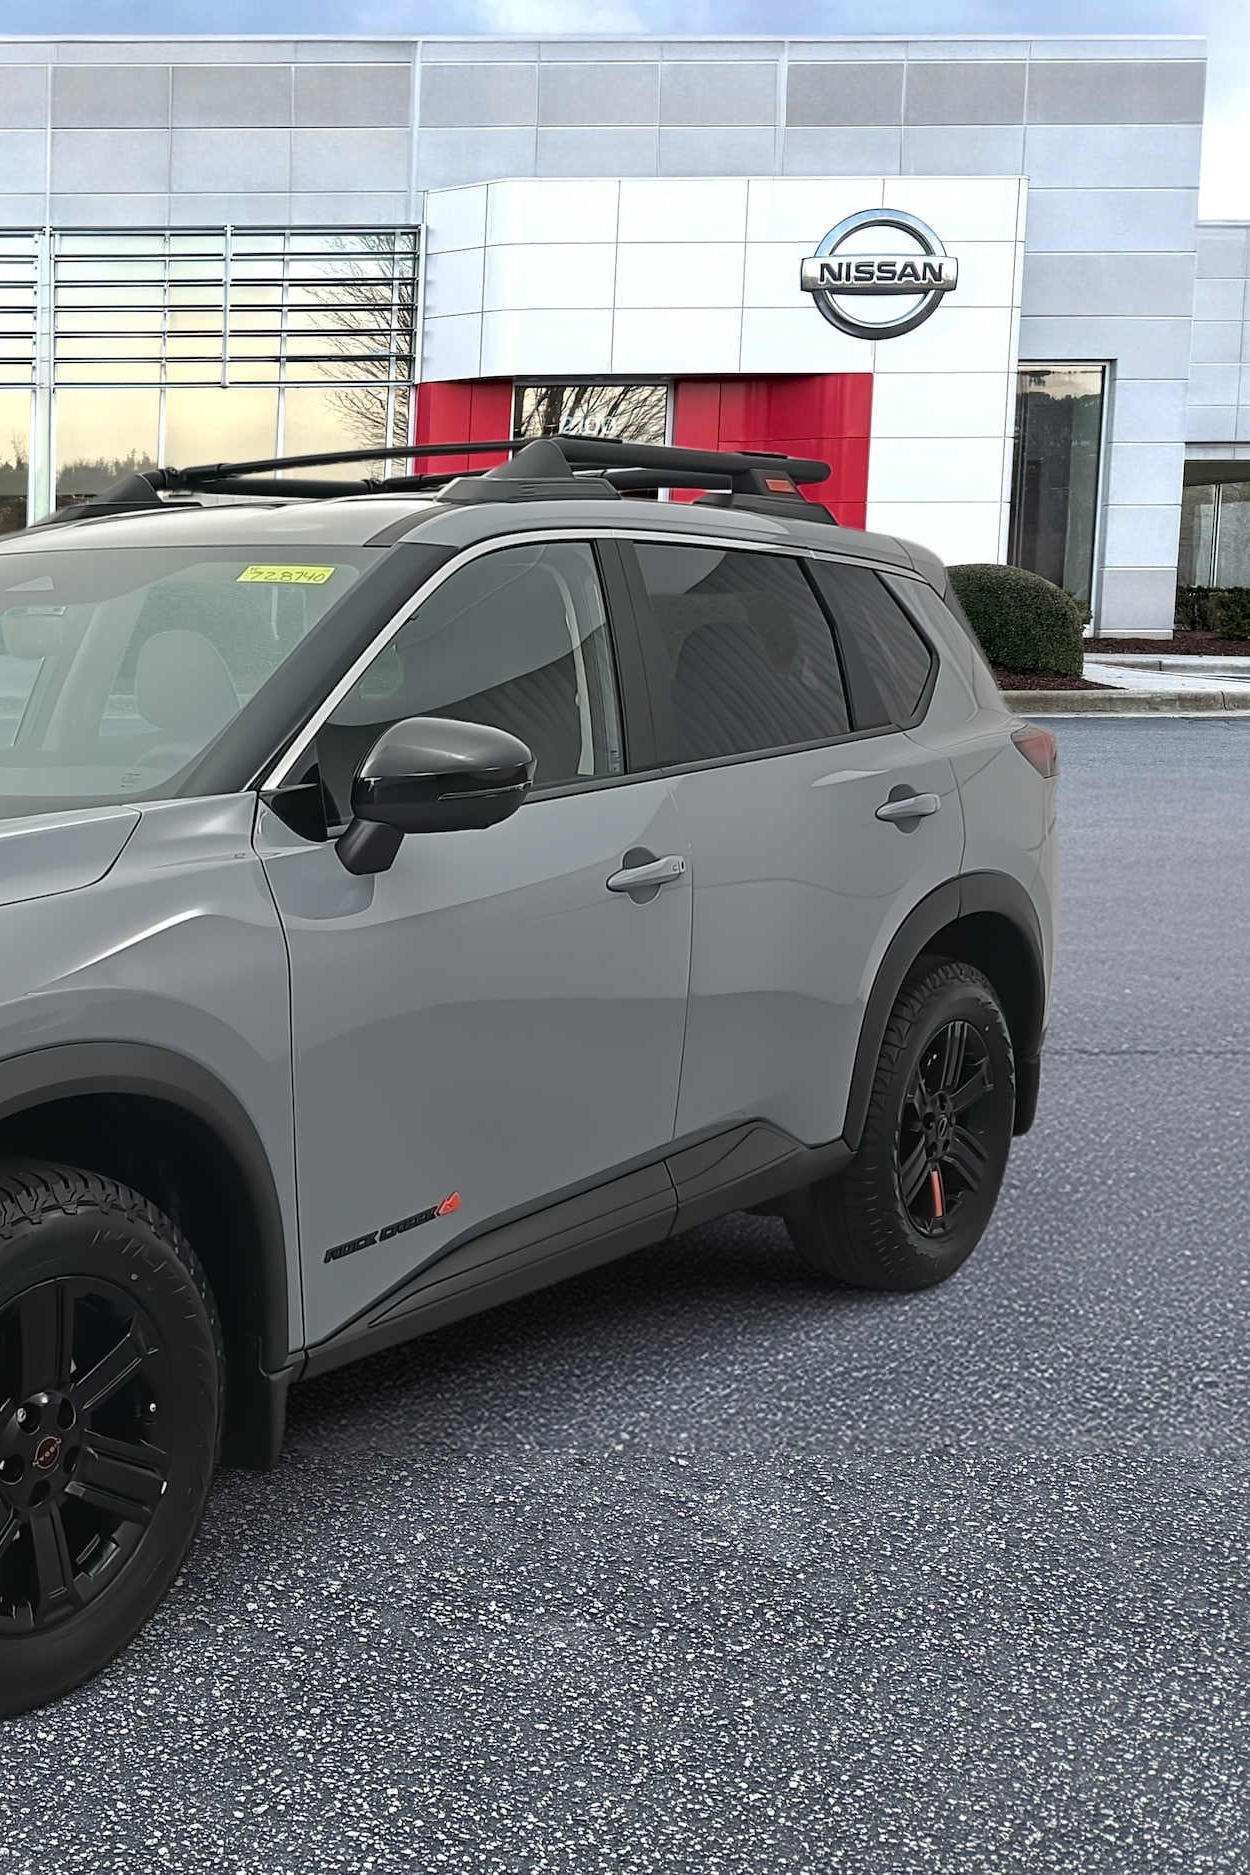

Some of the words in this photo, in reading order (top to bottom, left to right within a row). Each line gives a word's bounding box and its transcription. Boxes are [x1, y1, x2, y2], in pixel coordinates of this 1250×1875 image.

[819, 261, 944, 283] NISSAN
[323, 1230, 379, 1264] ROCK
[379, 1205, 438, 1242] CREEK
